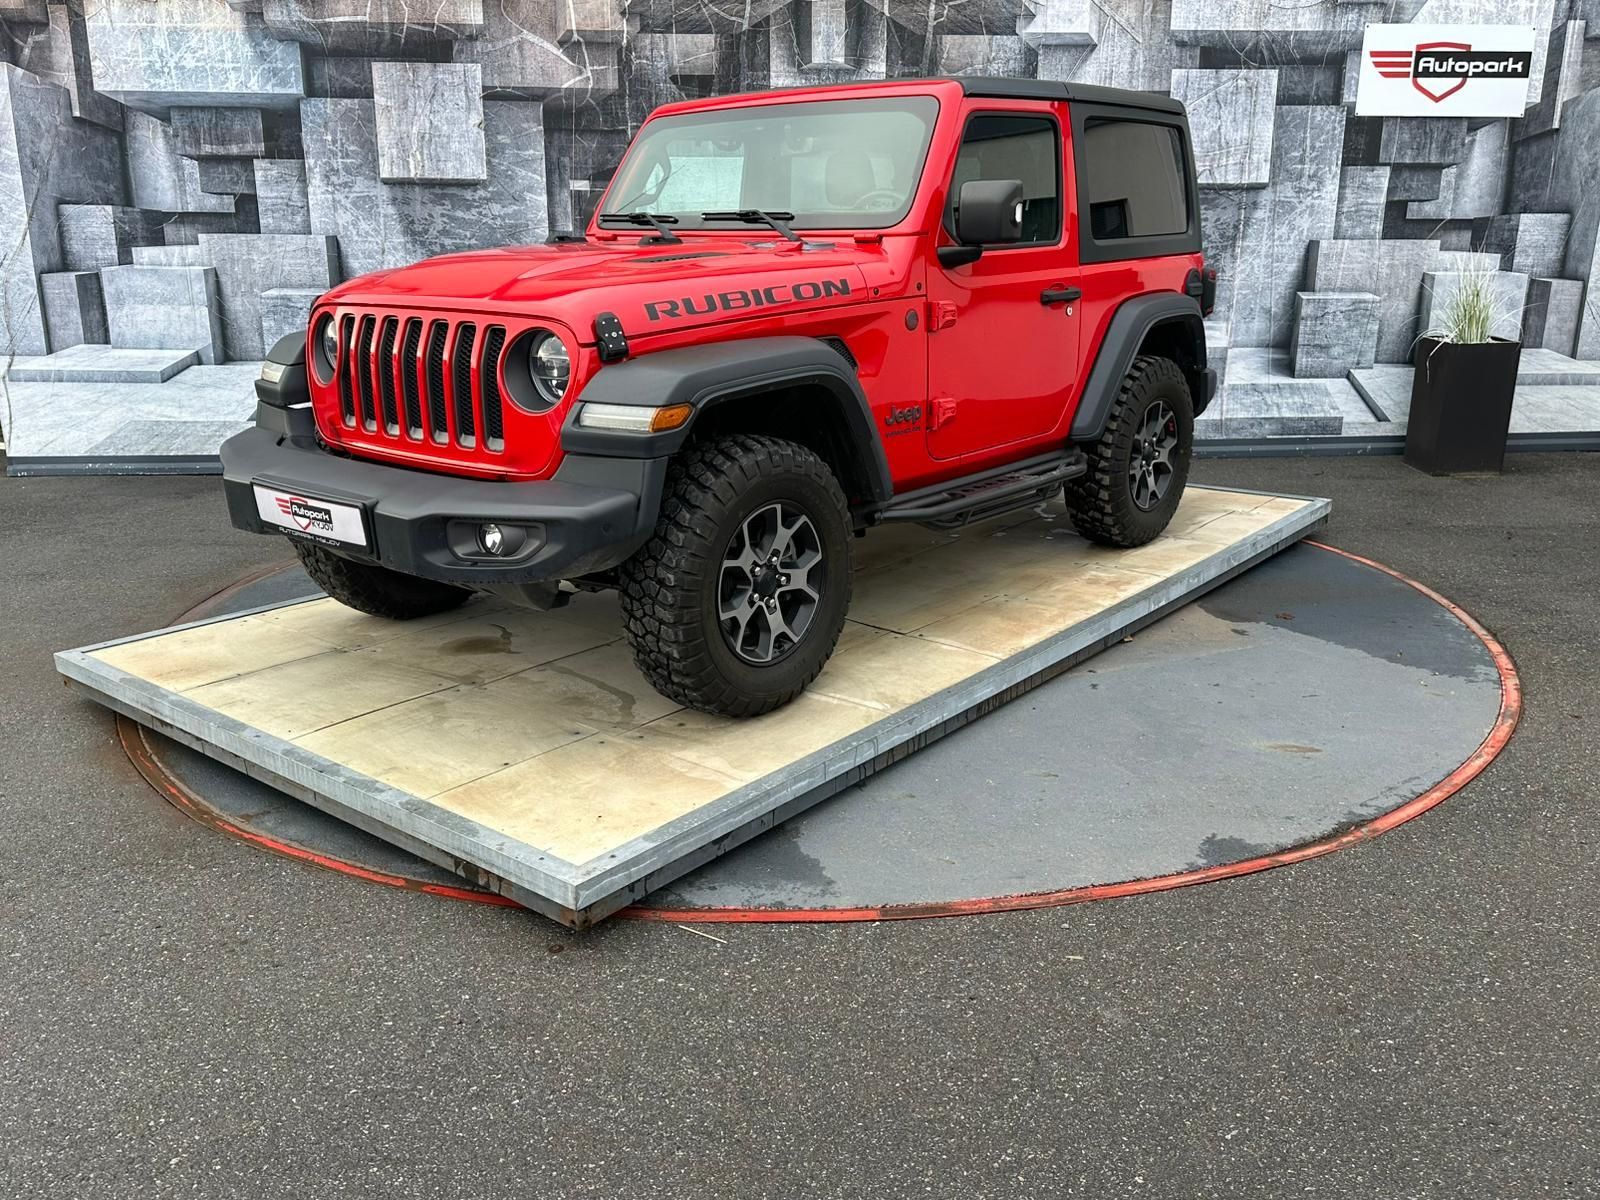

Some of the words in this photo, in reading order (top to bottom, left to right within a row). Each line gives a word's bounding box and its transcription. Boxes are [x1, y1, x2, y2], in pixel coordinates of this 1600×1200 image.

[1418, 57, 1523, 76] Autopark
[644, 278, 850, 321] RUBICON
[885, 405, 921, 426] Jeep
[292, 505, 330, 521] Autopark
[312, 520, 333, 532] KYJOV
